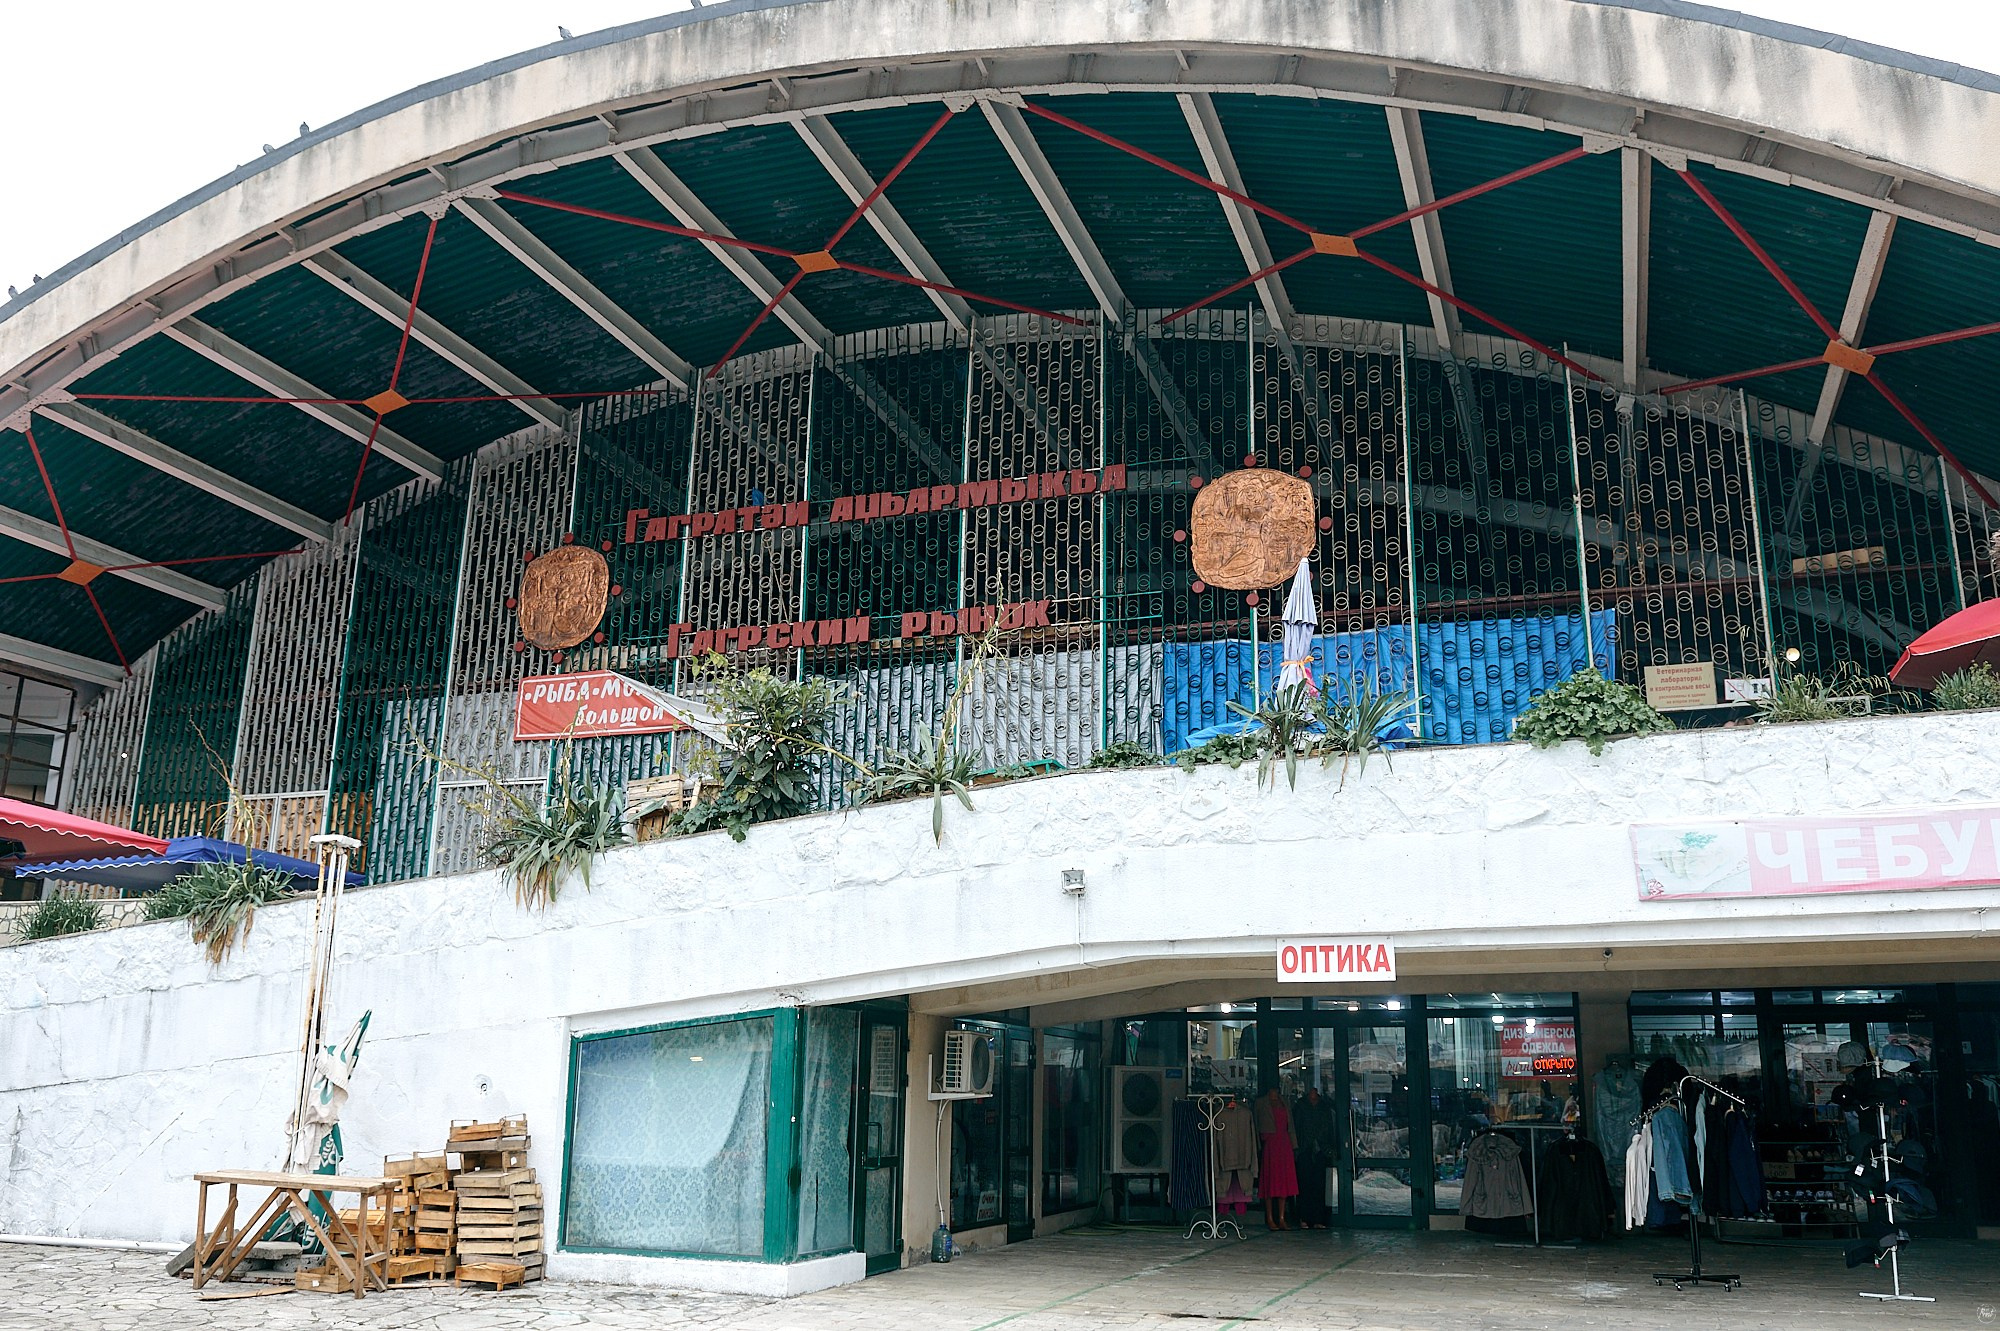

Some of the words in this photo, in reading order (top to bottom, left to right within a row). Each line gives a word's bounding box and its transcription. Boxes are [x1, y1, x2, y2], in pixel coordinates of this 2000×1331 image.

[533, 681, 589, 704] РЫБА
[1281, 944, 1392, 974] ОПТИКА
[1522, 1042, 1566, 1053] ОДЕЖДА
[1534, 1058, 1575, 1069] ОТКРЫТО
